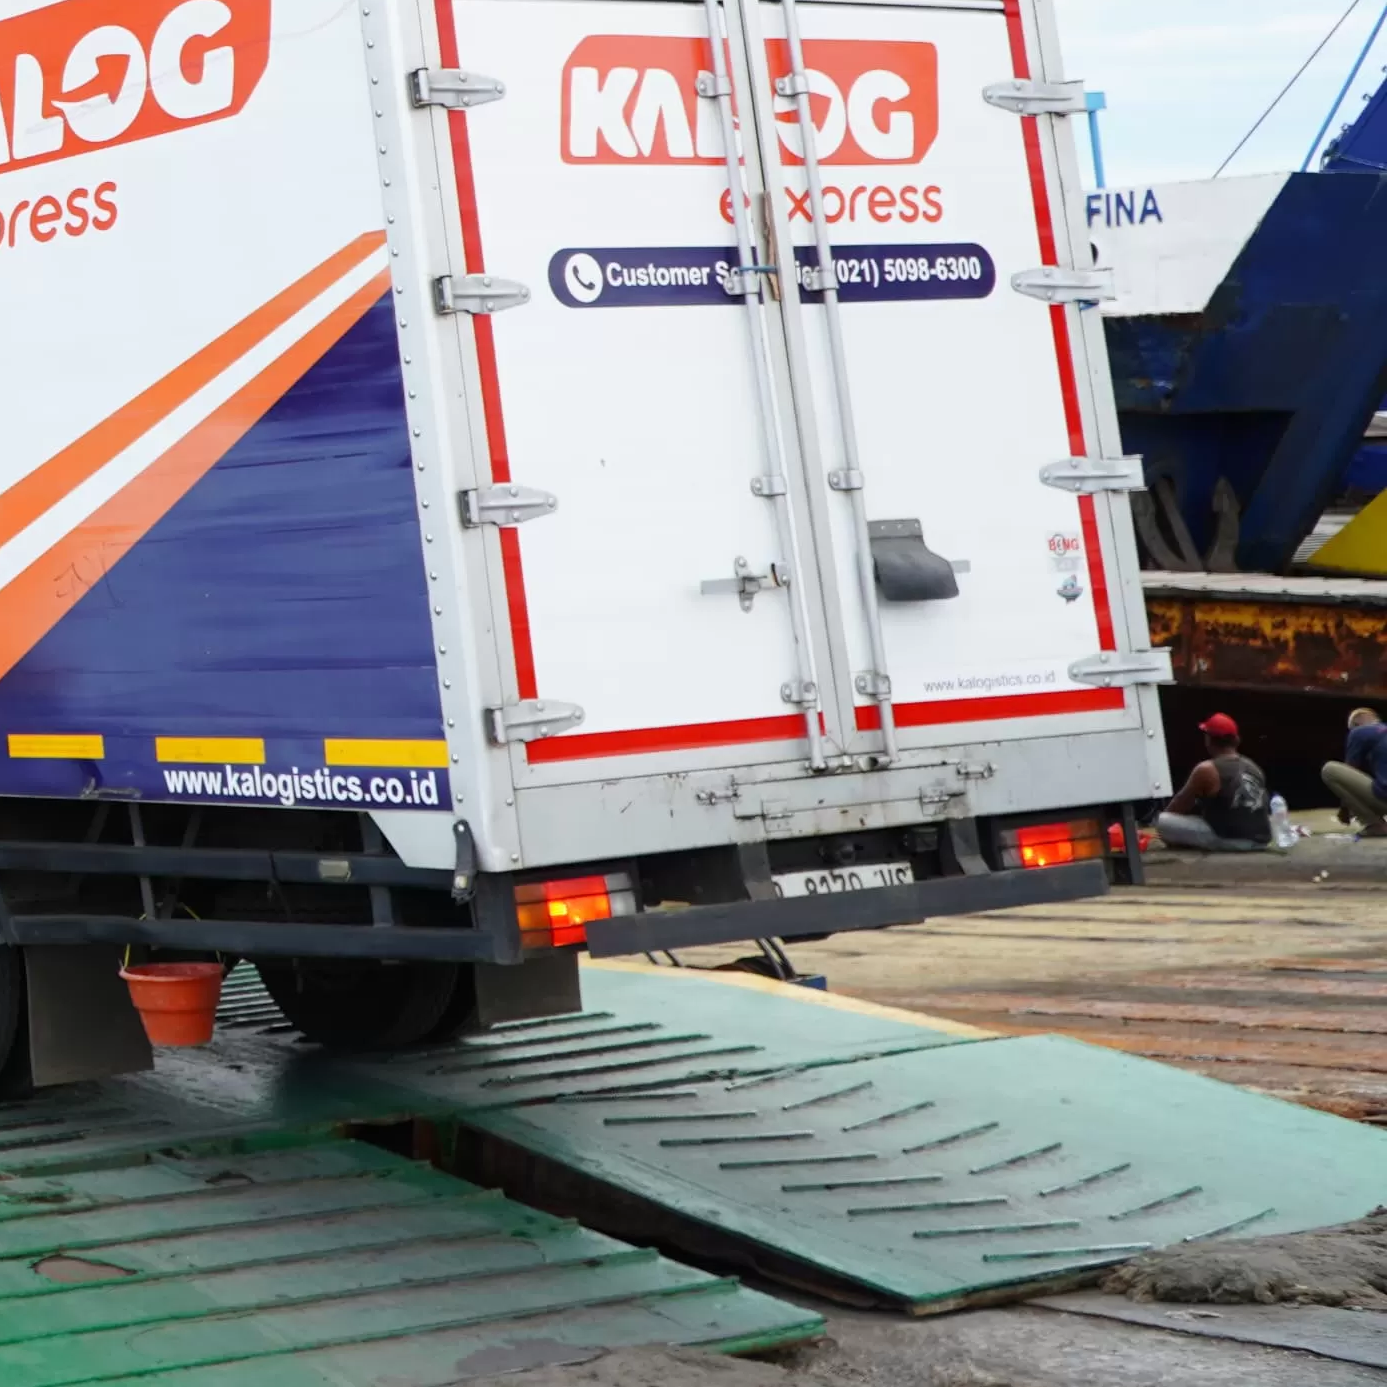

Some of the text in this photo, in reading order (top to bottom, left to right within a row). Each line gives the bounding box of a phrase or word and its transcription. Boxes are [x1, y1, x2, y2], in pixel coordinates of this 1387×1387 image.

[606, 262, 710, 287] Customer
[884, 257, 982, 282] 5098-6300
[164, 765, 439, 806] www.kalogistics.co.id
